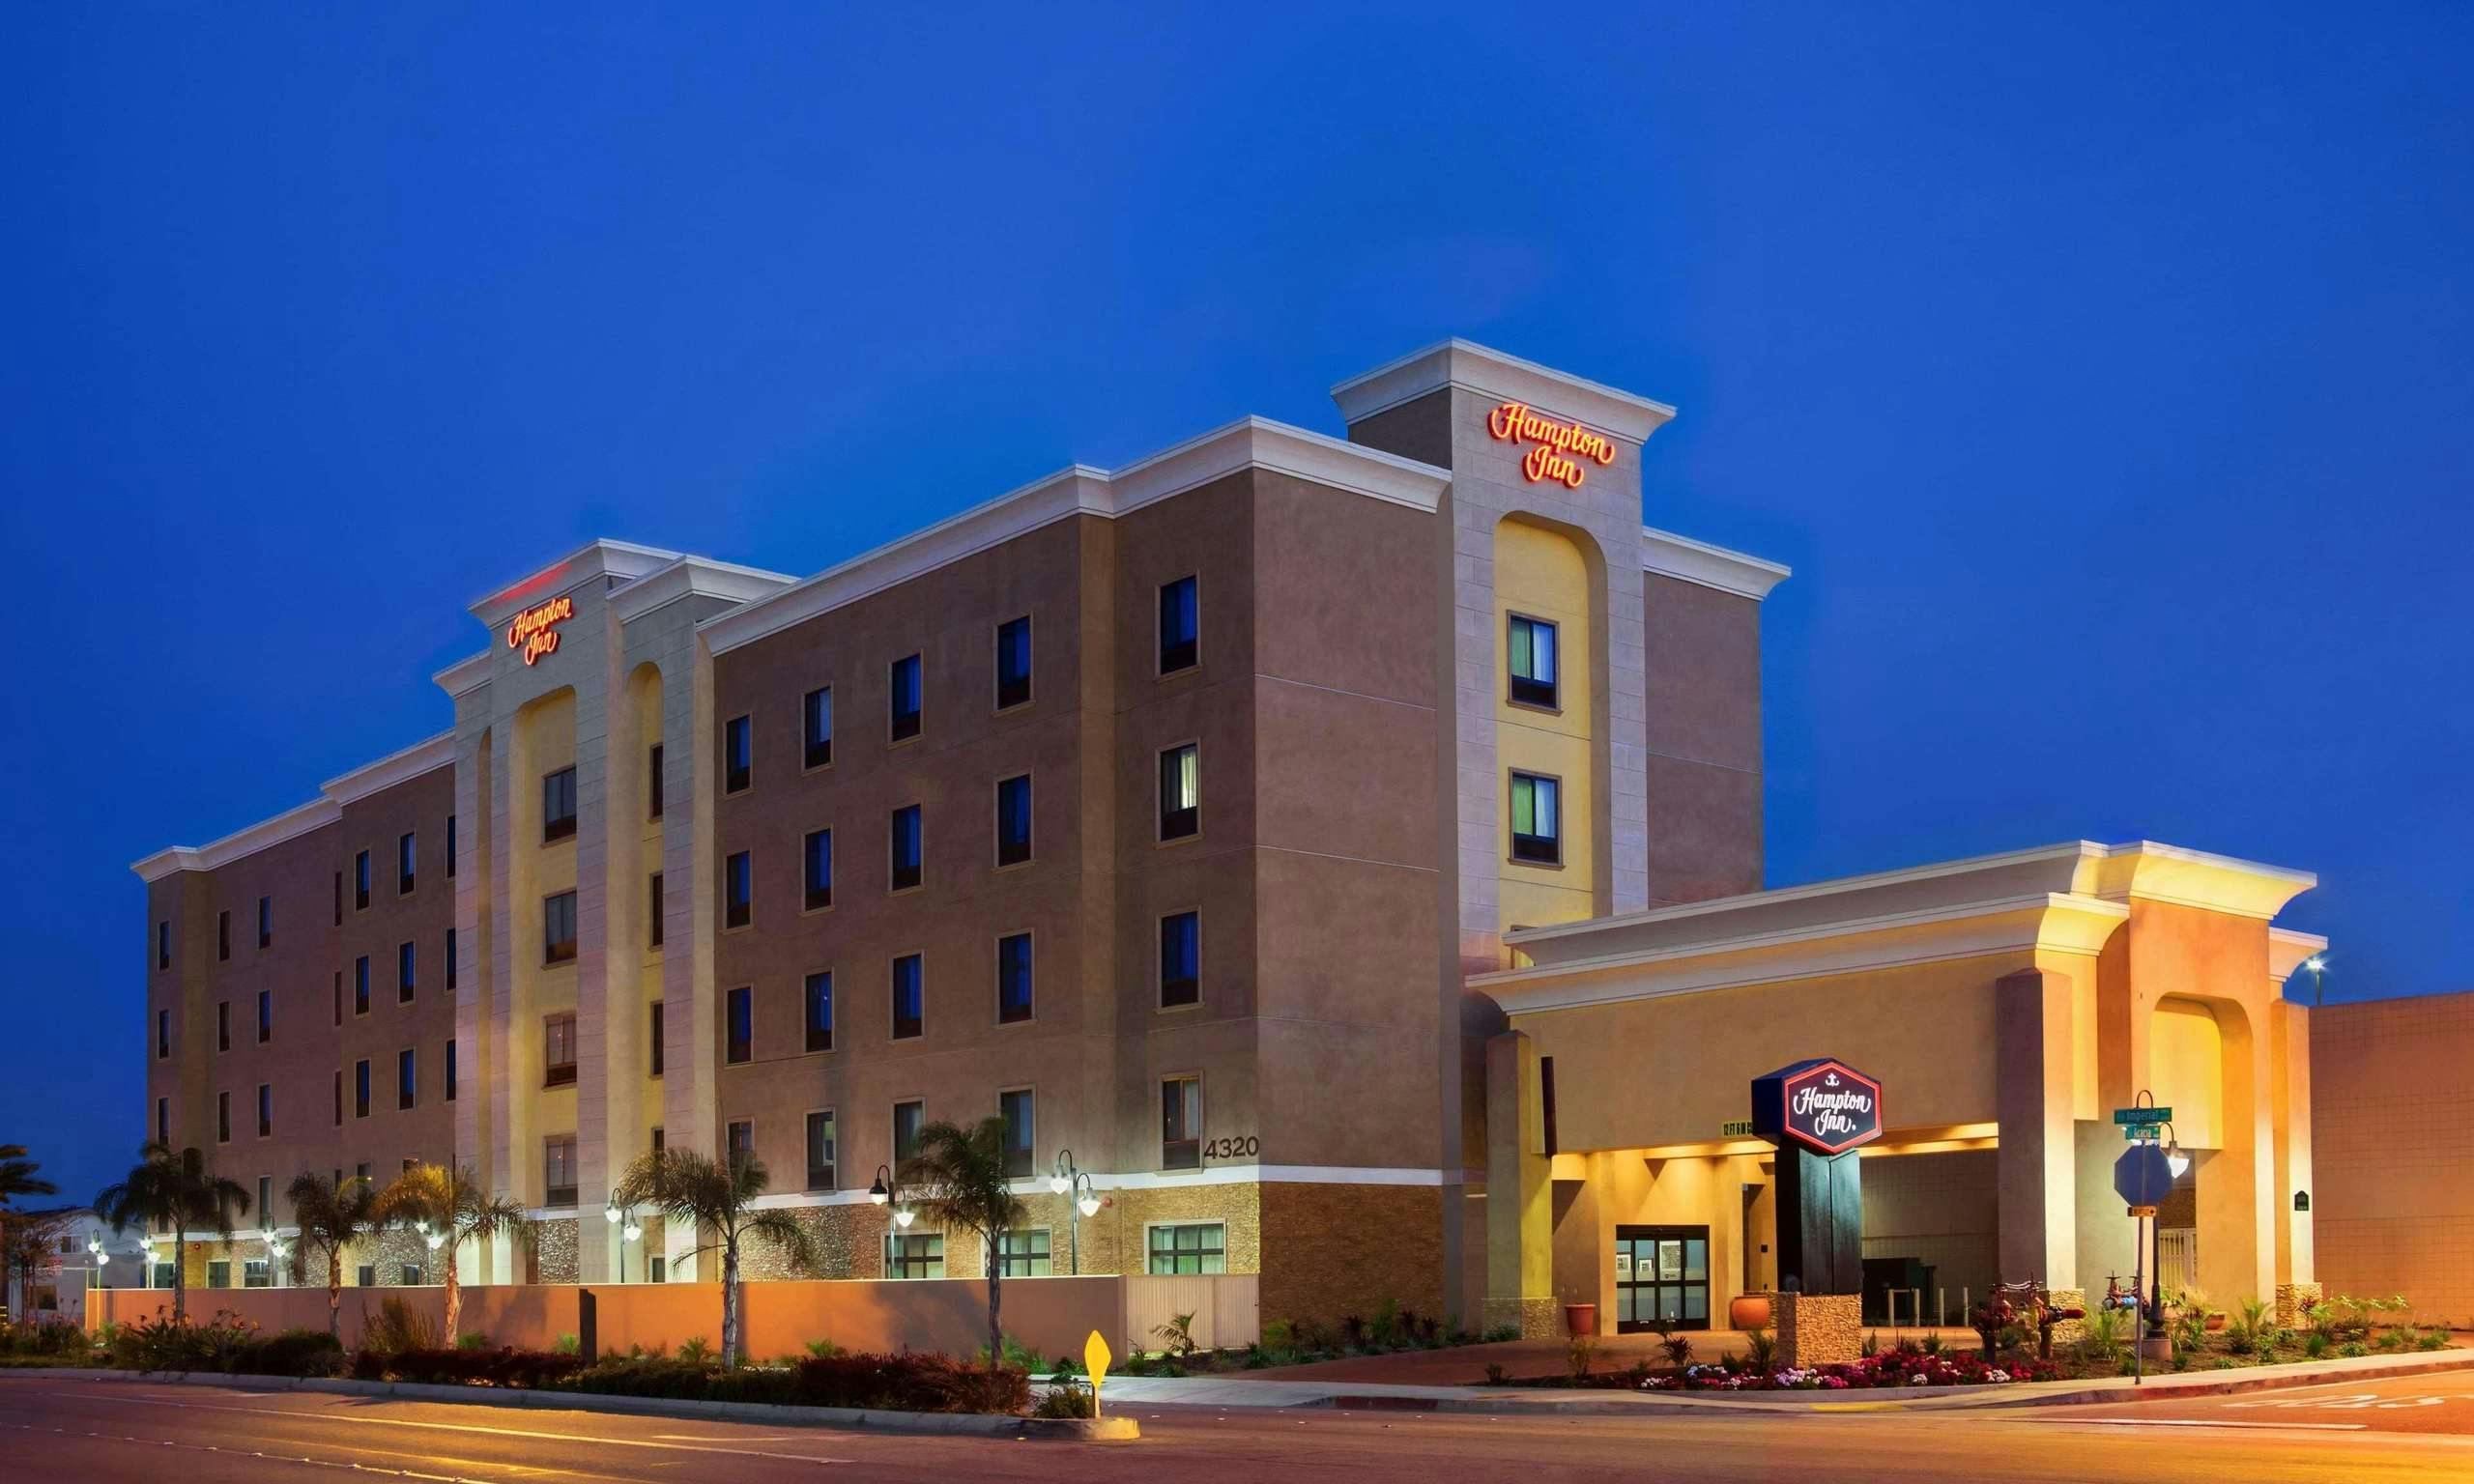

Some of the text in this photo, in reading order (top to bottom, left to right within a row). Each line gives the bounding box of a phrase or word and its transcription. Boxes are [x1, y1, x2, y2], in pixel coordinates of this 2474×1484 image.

[1488, 403, 1616, 465] Hampton
[1523, 445, 1585, 488] Inn
[508, 597, 572, 648] Hampton
[525, 630, 560, 666] Inn
[1793, 1086, 1872, 1115] Hampton
[2126, 1110, 2158, 1123] Imperial
[1204, 1136, 1259, 1159] 4320
